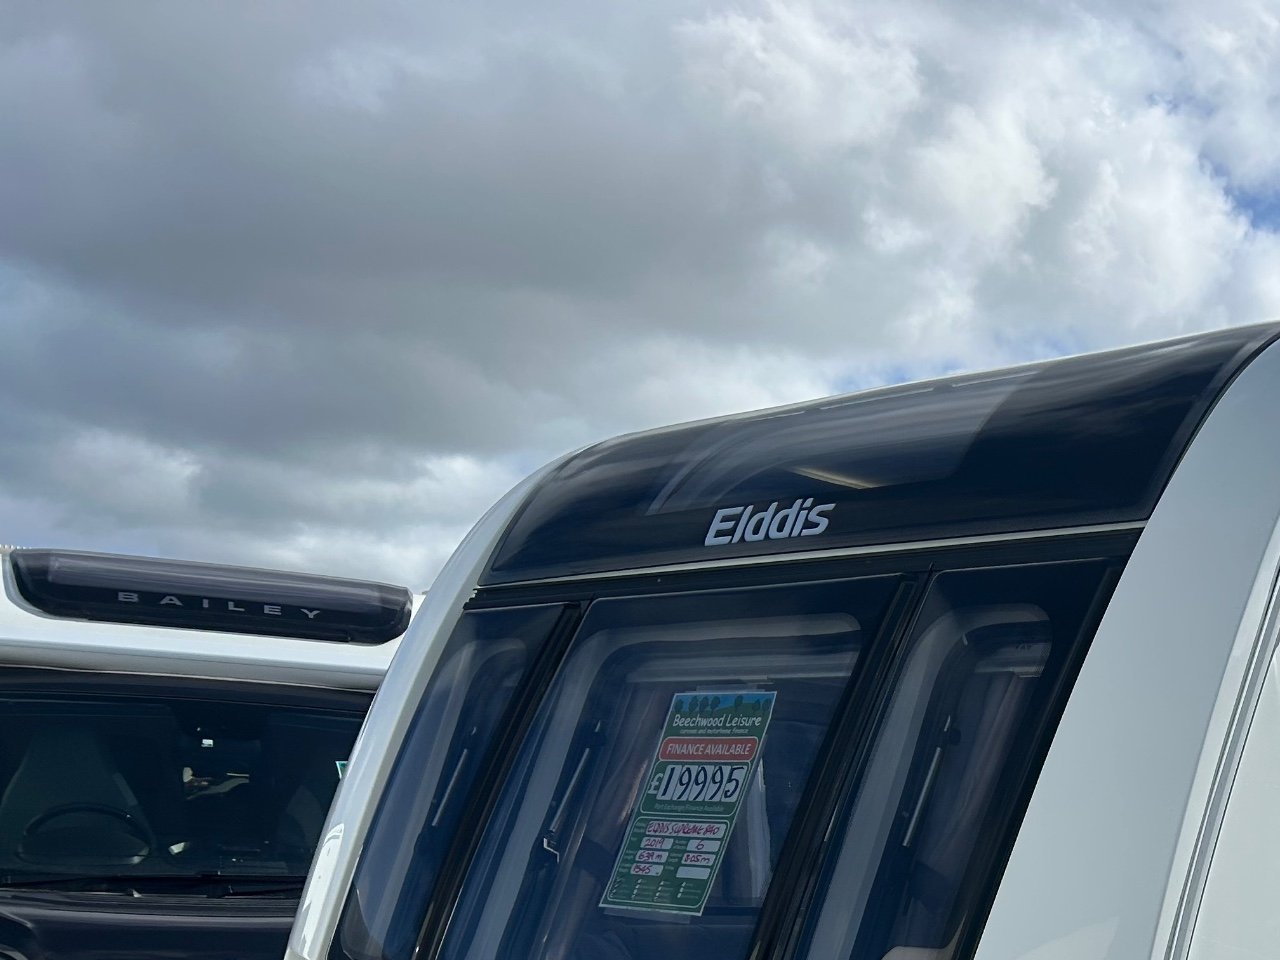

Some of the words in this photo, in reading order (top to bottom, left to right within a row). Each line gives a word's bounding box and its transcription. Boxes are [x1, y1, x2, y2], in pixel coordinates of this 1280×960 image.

[704, 497, 837, 547] Elddis
[117, 591, 321, 619] BAILEY
[673, 713, 725, 727] Beechwood
[726, 714, 762, 727] Leisure
[666, 744, 704, 755] FINANCE
[703, 744, 751, 755] AVAILABLE
